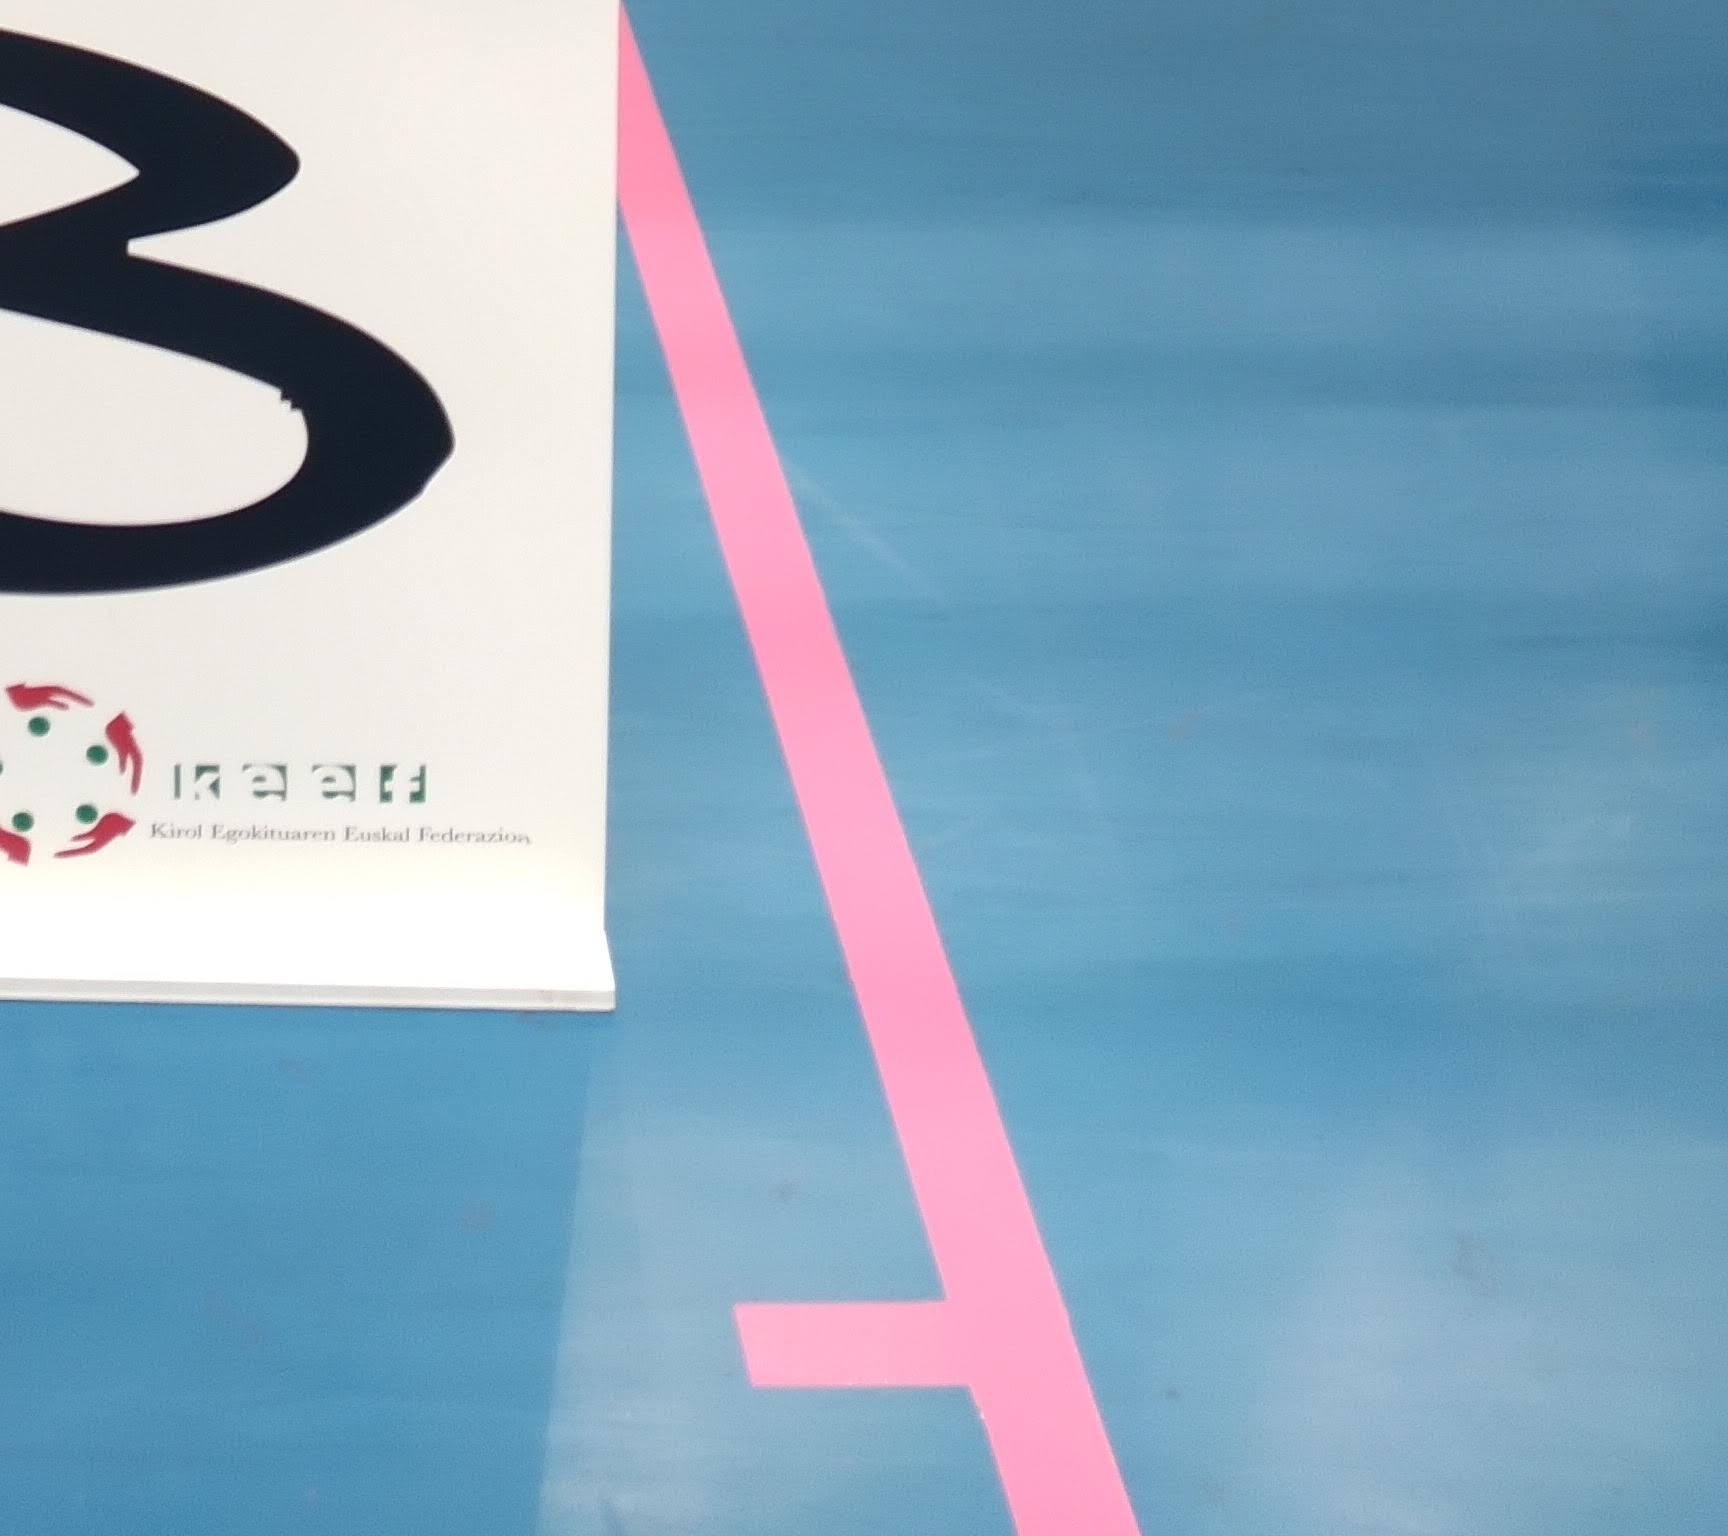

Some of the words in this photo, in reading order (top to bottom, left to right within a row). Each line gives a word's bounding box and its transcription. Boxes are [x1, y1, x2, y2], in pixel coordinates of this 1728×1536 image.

[150, 821, 203, 841] Kirol
[211, 823, 337, 845] Egokituaren
[344, 824, 411, 843] Euskal
